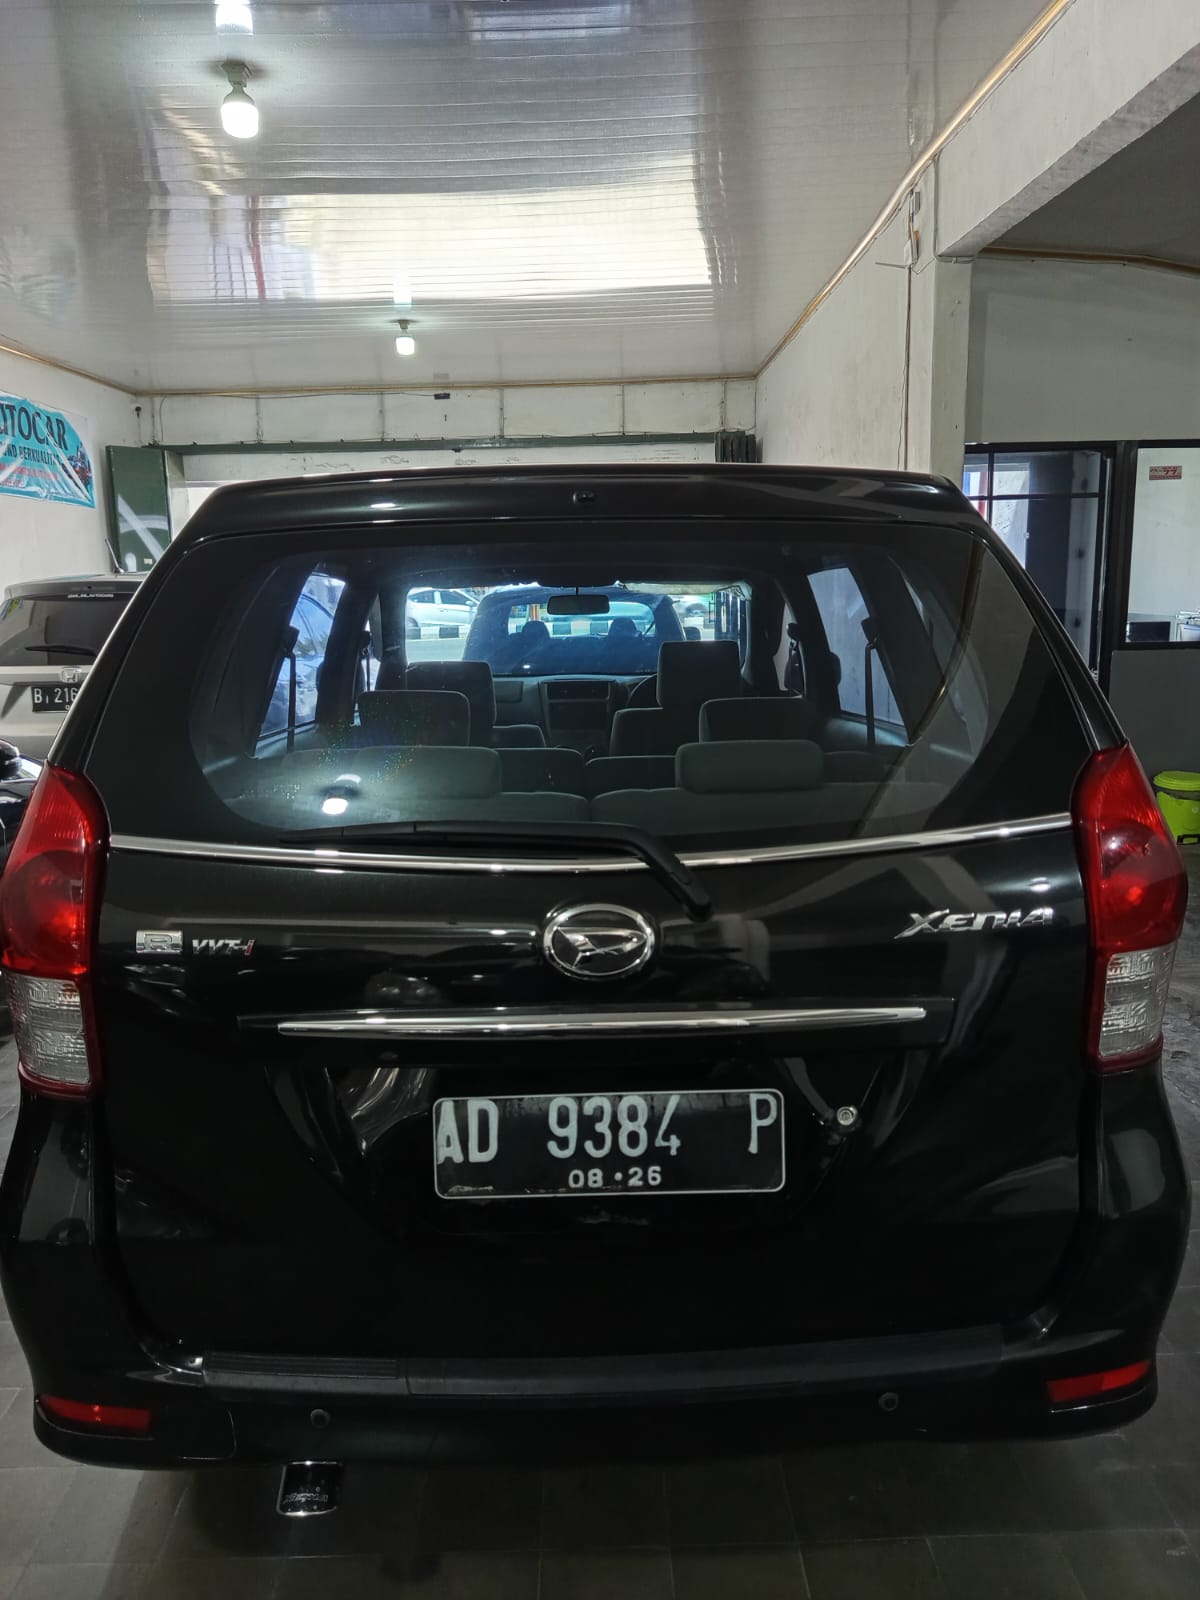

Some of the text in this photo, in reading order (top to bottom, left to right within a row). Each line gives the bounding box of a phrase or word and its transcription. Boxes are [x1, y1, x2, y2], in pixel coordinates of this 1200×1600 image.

[34, 688, 42, 704] B
[436, 1093, 778, 1165] AD 9384 P
